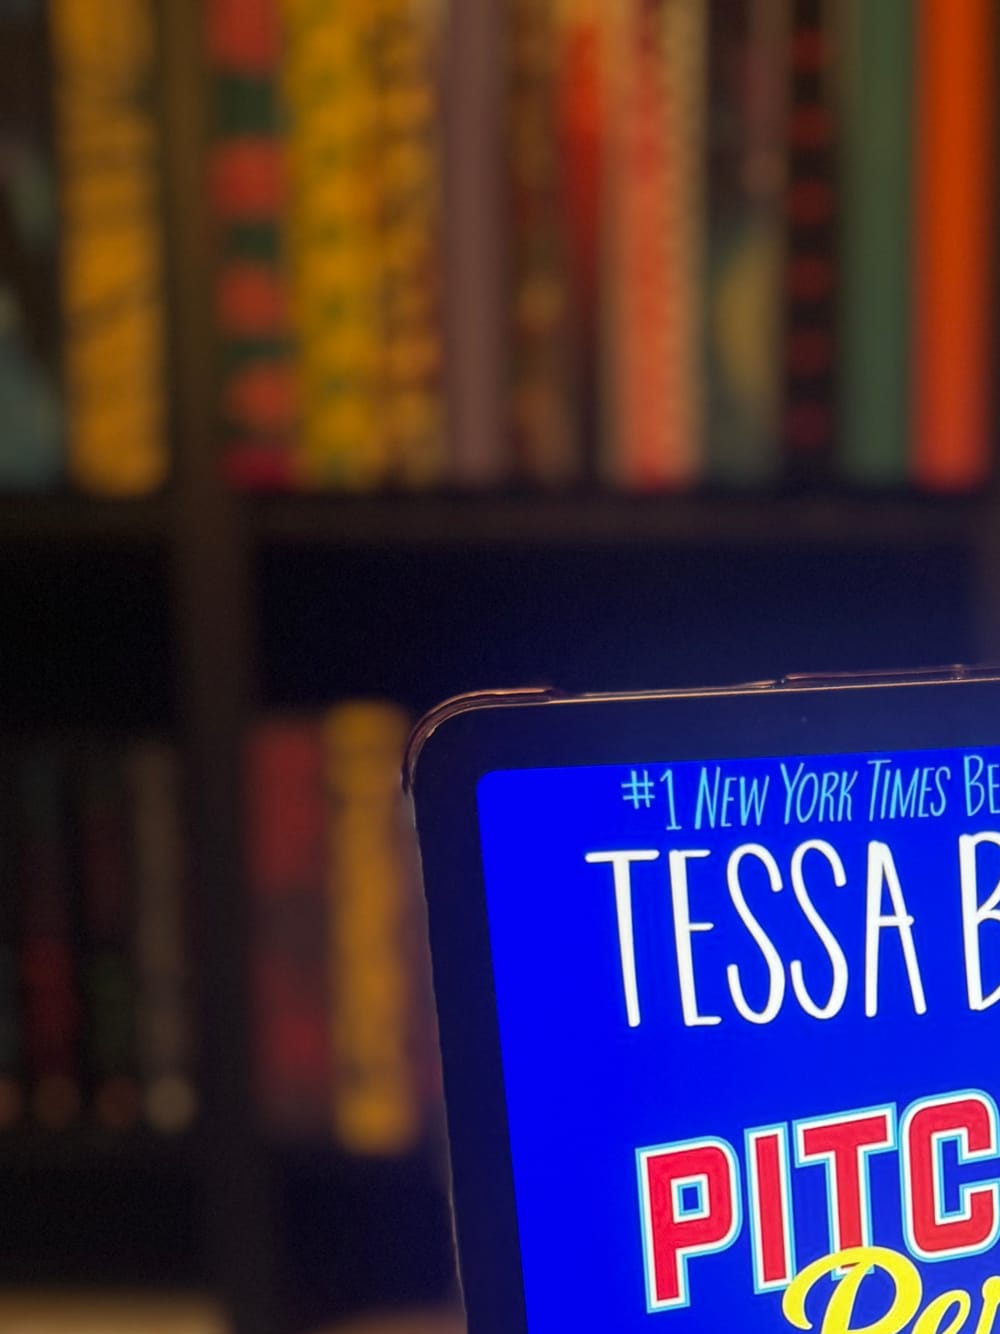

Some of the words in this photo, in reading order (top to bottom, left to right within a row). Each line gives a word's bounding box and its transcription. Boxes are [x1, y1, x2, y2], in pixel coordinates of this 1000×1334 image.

[621, 768, 682, 830] #1
[694, 766, 769, 830] NEW
[780, 762, 858, 825] YORK
[867, 759, 951, 822] TIMES
[585, 839, 926, 1027] TESSA
